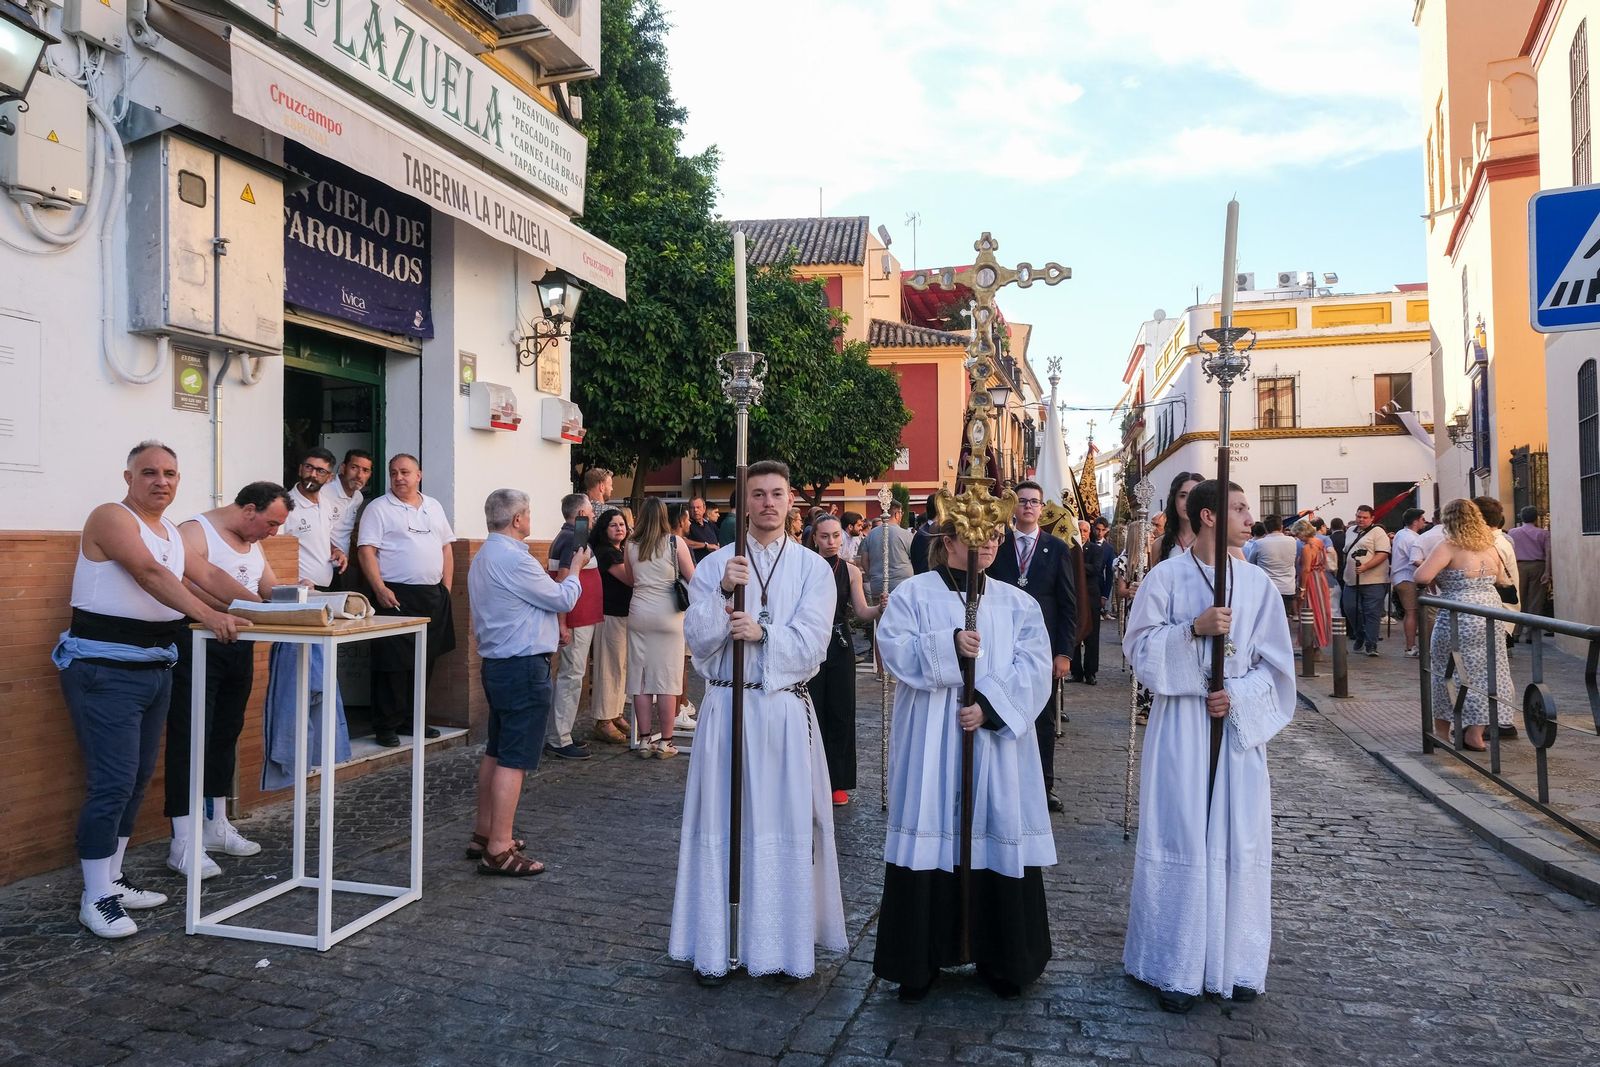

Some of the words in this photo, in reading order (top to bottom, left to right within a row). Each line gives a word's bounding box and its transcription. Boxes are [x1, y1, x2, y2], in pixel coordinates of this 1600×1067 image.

[270, 84, 343, 136] Cruzcampo
[544, 155, 550, 168] A
[550, 159, 560, 174] LA
[560, 165, 583, 189] BRASA
[550, 141, 572, 163] FRITO
[402, 152, 471, 216] TABERNA
[474, 190, 491, 226] LA
[494, 201, 551, 256] PLAZUELA
[537, 172, 568, 197] CASERAS
[317, 180, 391, 237] CIELO
[395, 215, 425, 249] DE
